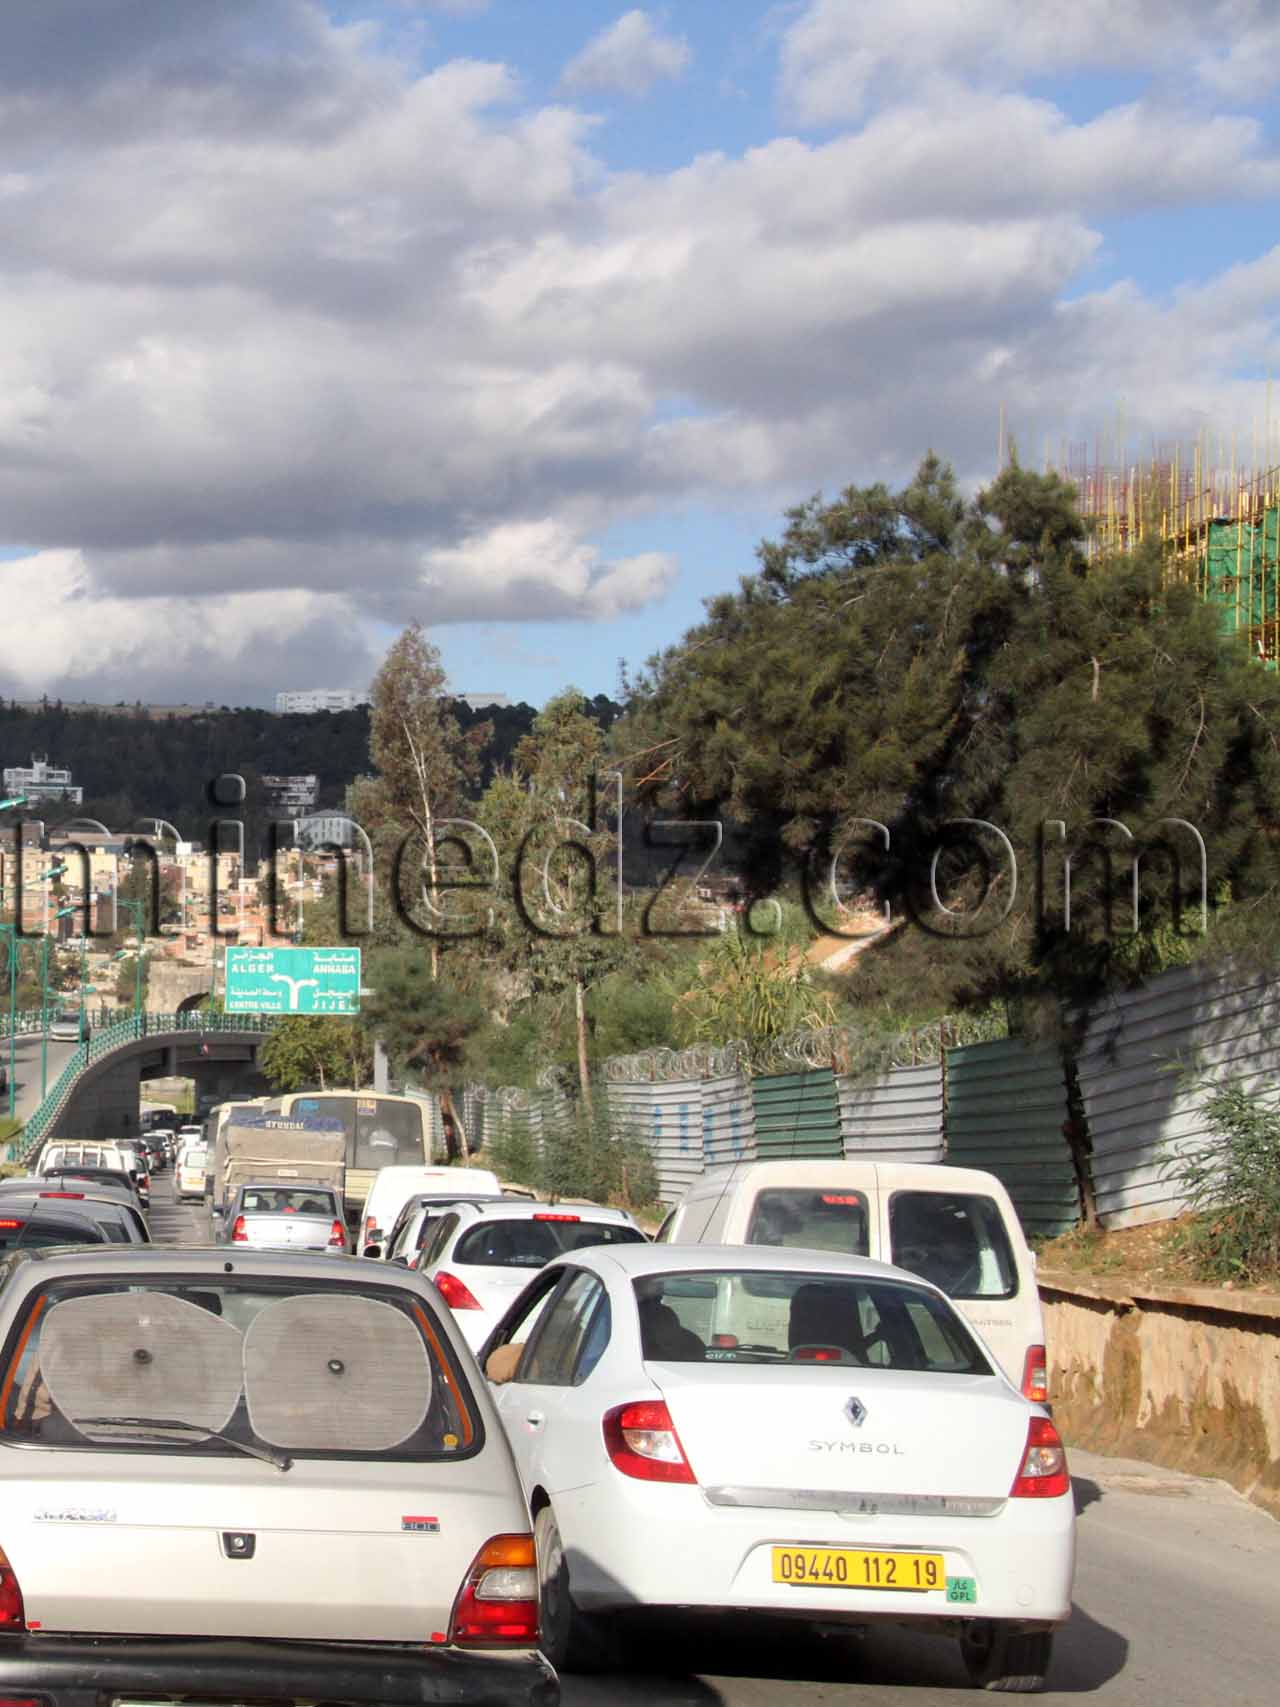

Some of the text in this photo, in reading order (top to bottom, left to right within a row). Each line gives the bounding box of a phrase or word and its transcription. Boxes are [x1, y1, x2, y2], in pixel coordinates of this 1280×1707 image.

[231, 963, 275, 974] ALGER
[314, 964, 356, 974] ANNABA
[231, 1001, 281, 1009] CENTRE VILLE
[313, 1000, 356, 1010] JIJEL
[265, 1120, 305, 1130] HYUNDAI
[807, 1439, 905, 1456] SYMBOL
[780, 1553, 938, 1586] 09440 112 19
[949, 1590, 971, 1602] GPL
